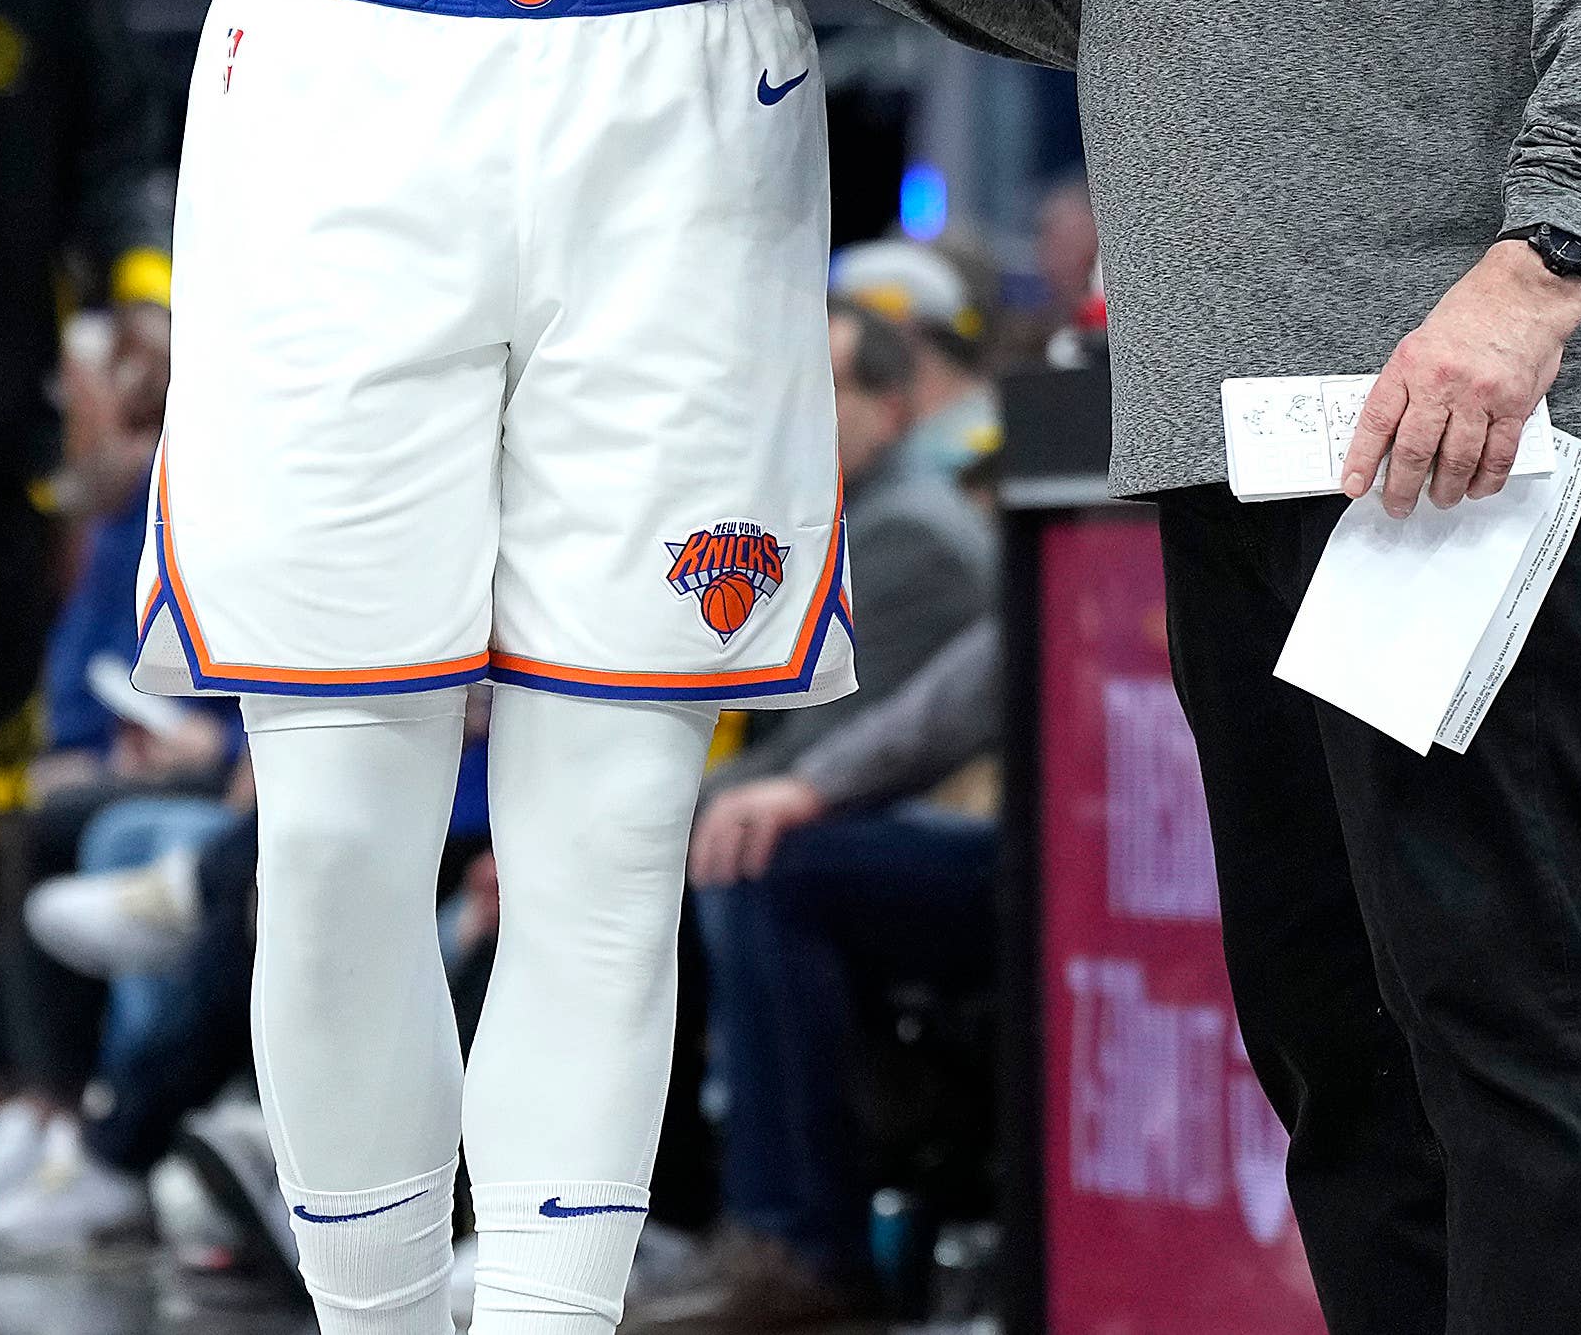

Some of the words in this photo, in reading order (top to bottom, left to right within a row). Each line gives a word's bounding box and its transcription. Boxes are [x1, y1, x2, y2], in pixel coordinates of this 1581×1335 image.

[713, 521, 736, 534] NEW
[738, 521, 761, 536] YORK
[666, 529, 783, 585] KNICKS
[1547, 528, 1568, 571] ASSOCIATION
[1497, 630, 1514, 662] QUARTER
[1489, 663, 1505, 690] OFFICIAL
[1463, 694, 1481, 725] QUARTER
[1457, 720, 1473, 746] REPORT
